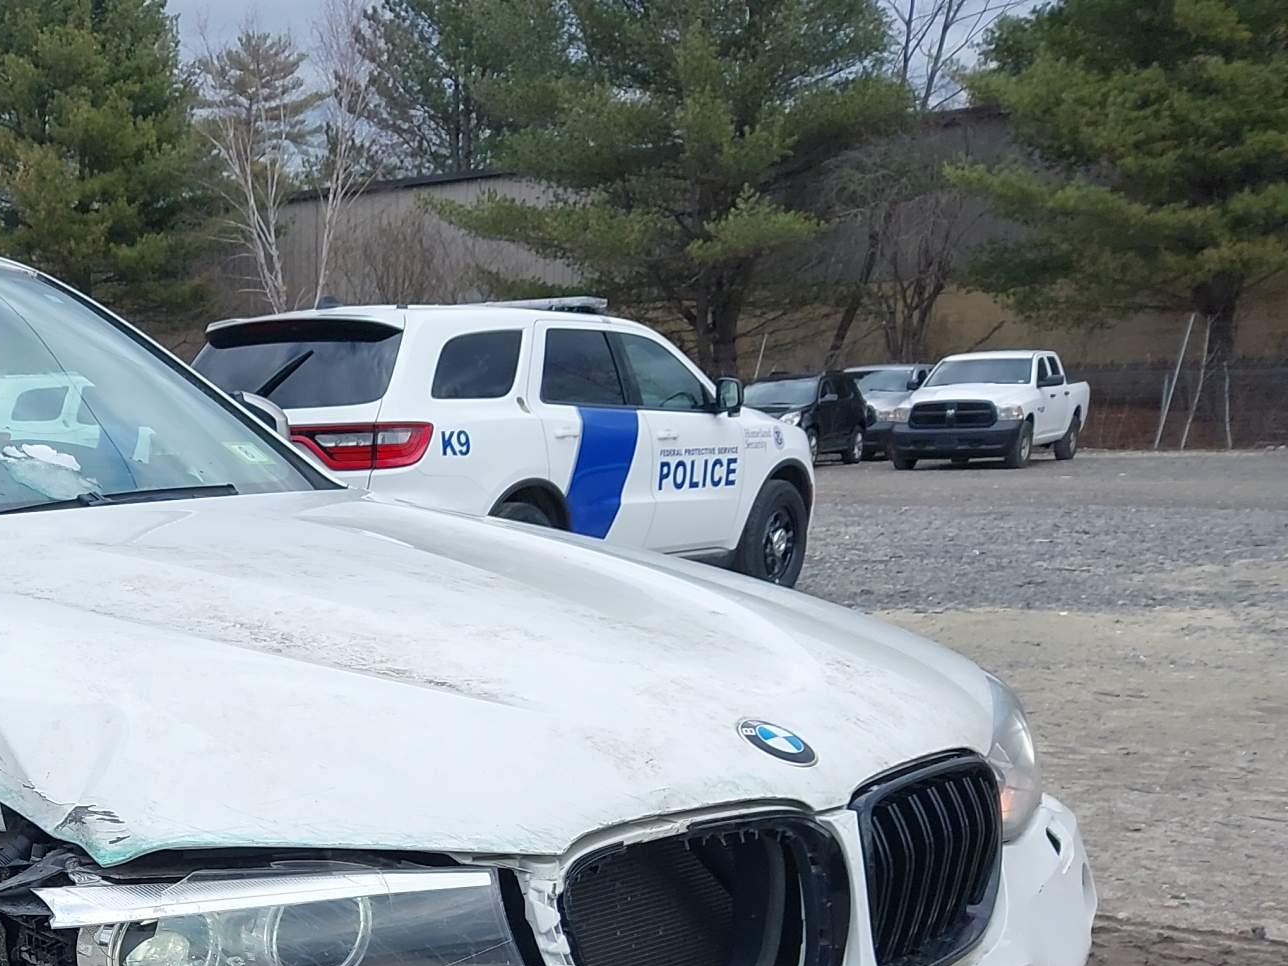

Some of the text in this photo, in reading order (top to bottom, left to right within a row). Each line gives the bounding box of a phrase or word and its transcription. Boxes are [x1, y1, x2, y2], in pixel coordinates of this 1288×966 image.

[441, 430, 471, 456] K9
[659, 446, 738, 457] FEDERAL PROTECTIVE SERVICE
[658, 458, 738, 491] POLICE
